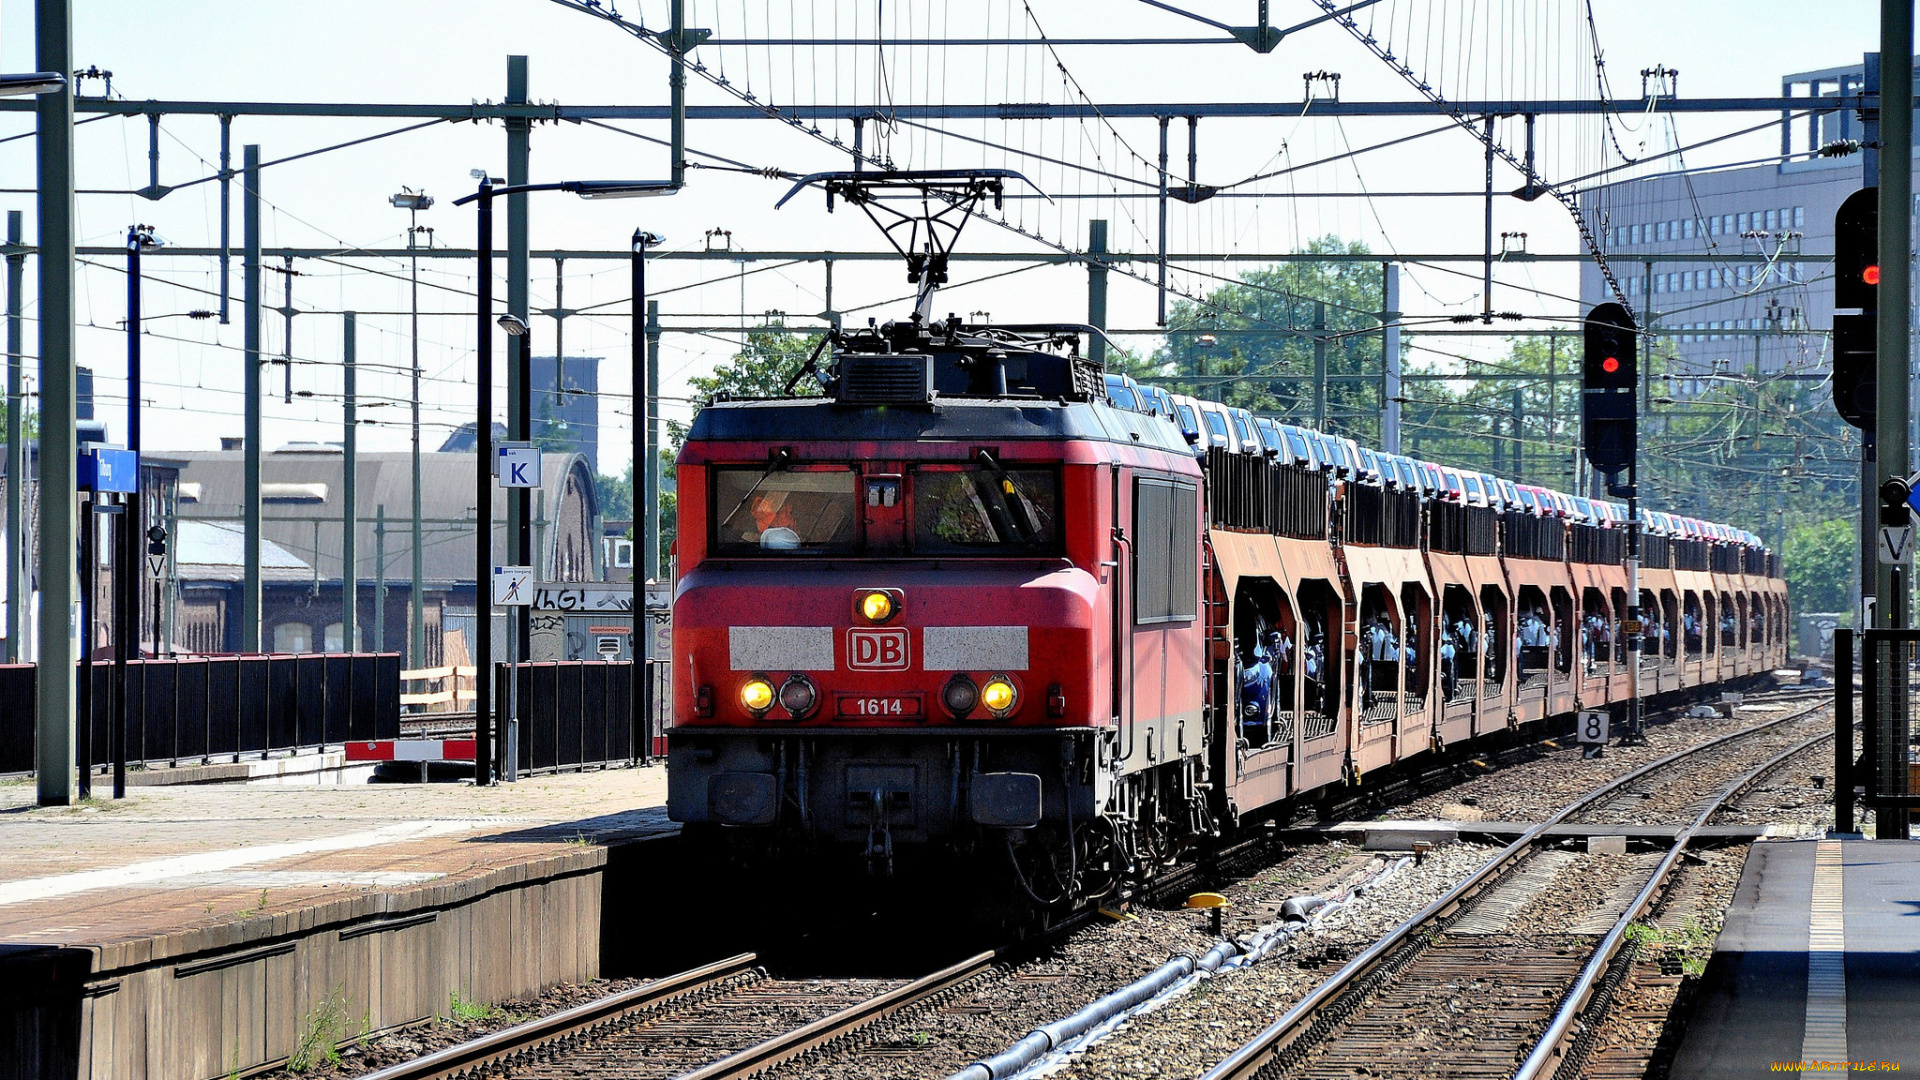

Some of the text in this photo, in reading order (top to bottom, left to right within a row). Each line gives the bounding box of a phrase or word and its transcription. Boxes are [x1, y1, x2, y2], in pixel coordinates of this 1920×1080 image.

[511, 463, 528, 484] K
[1882, 528, 1910, 560] V
[148, 556, 165, 577] V
[856, 635, 902, 664] DB
[857, 699, 902, 715] 1614
[1585, 713, 1601, 740] 8
